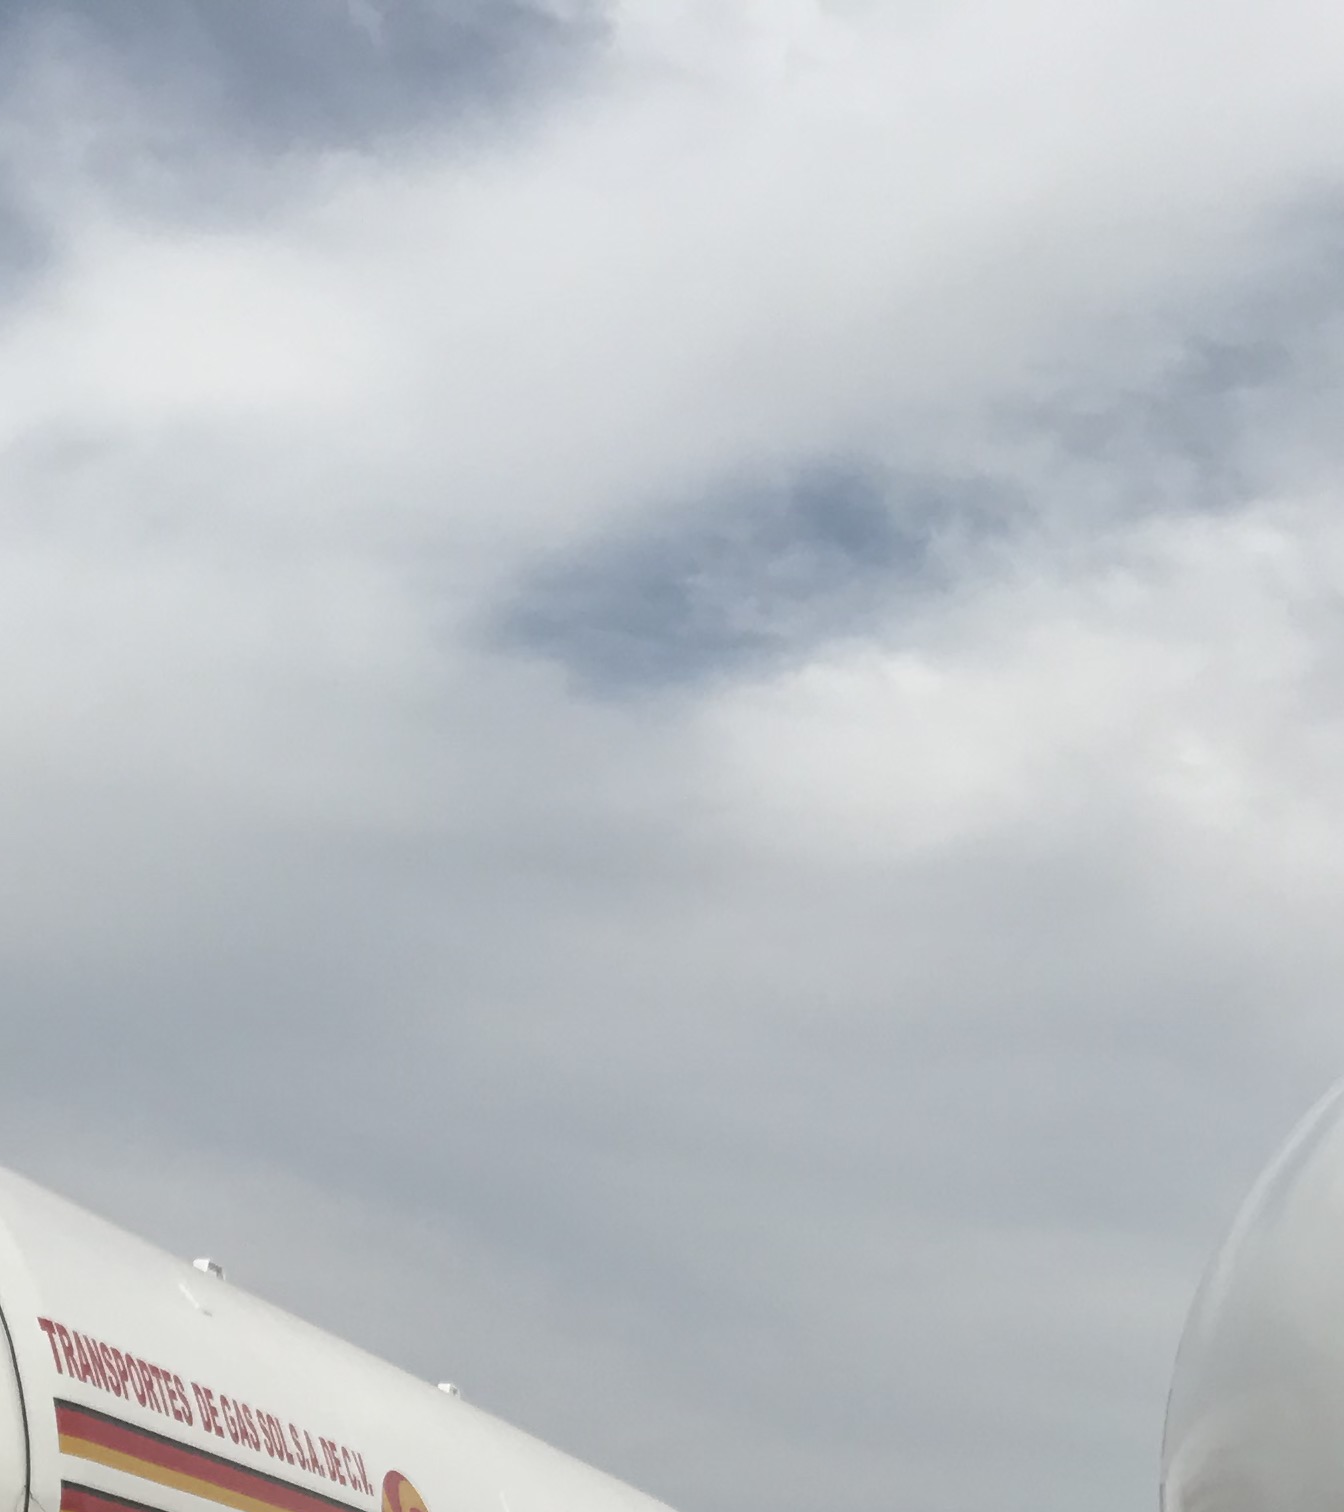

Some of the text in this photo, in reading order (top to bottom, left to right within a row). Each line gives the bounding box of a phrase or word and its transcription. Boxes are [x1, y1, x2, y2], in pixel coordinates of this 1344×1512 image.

[37, 1317, 193, 1427] TRANSPORTES
[191, 1382, 224, 1438] DE
[220, 1394, 261, 1452] GAS
[256, 1409, 295, 1465] SOL
[289, 1423, 326, 1478] S.A.
[318, 1436, 347, 1486] DE
